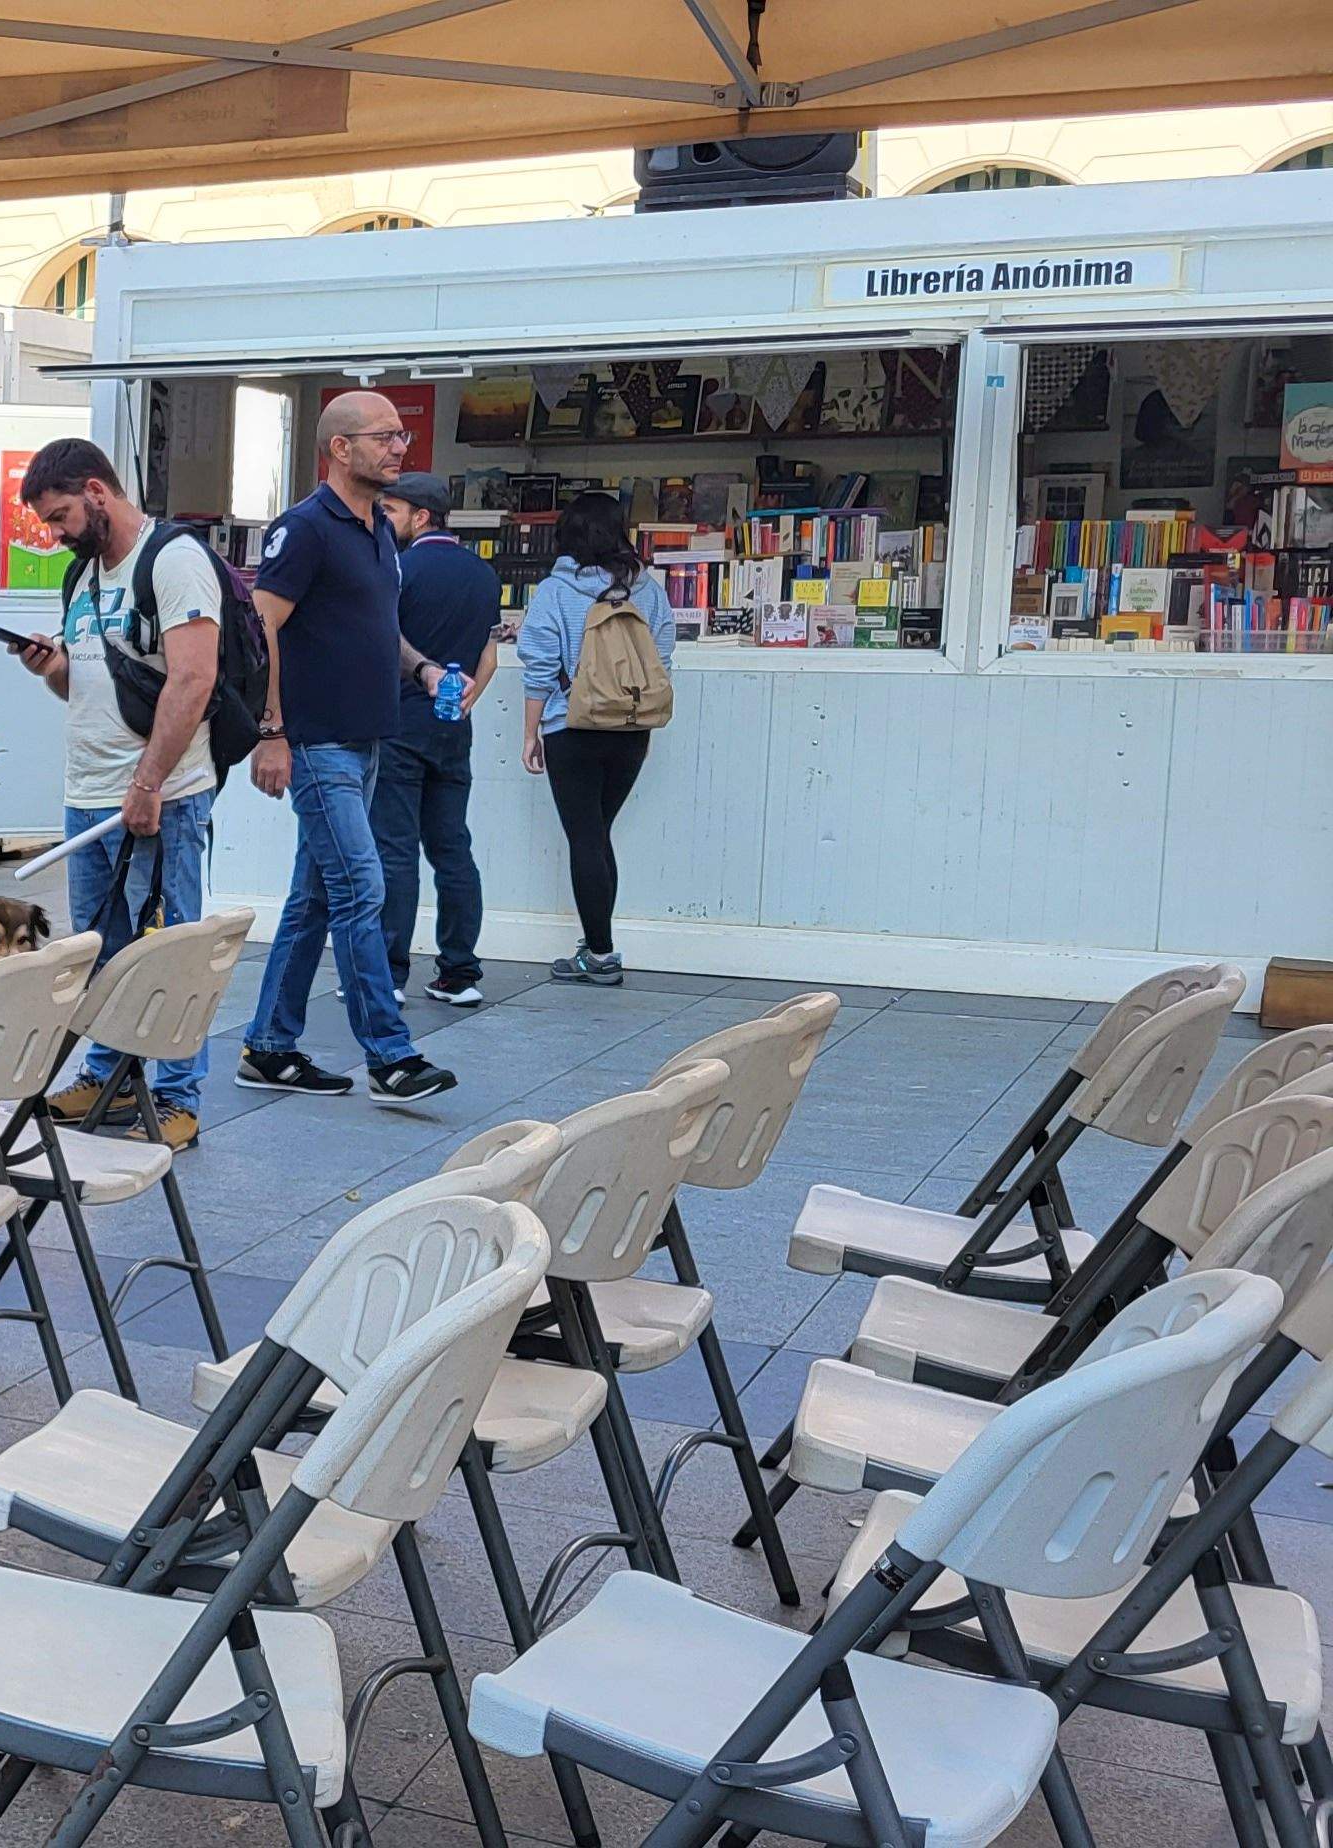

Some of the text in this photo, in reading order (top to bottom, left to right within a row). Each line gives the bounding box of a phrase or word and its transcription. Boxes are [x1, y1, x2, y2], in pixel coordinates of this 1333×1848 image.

[866, 258, 1134, 298] Librería Anónima
[264, 527, 288, 559] 3
